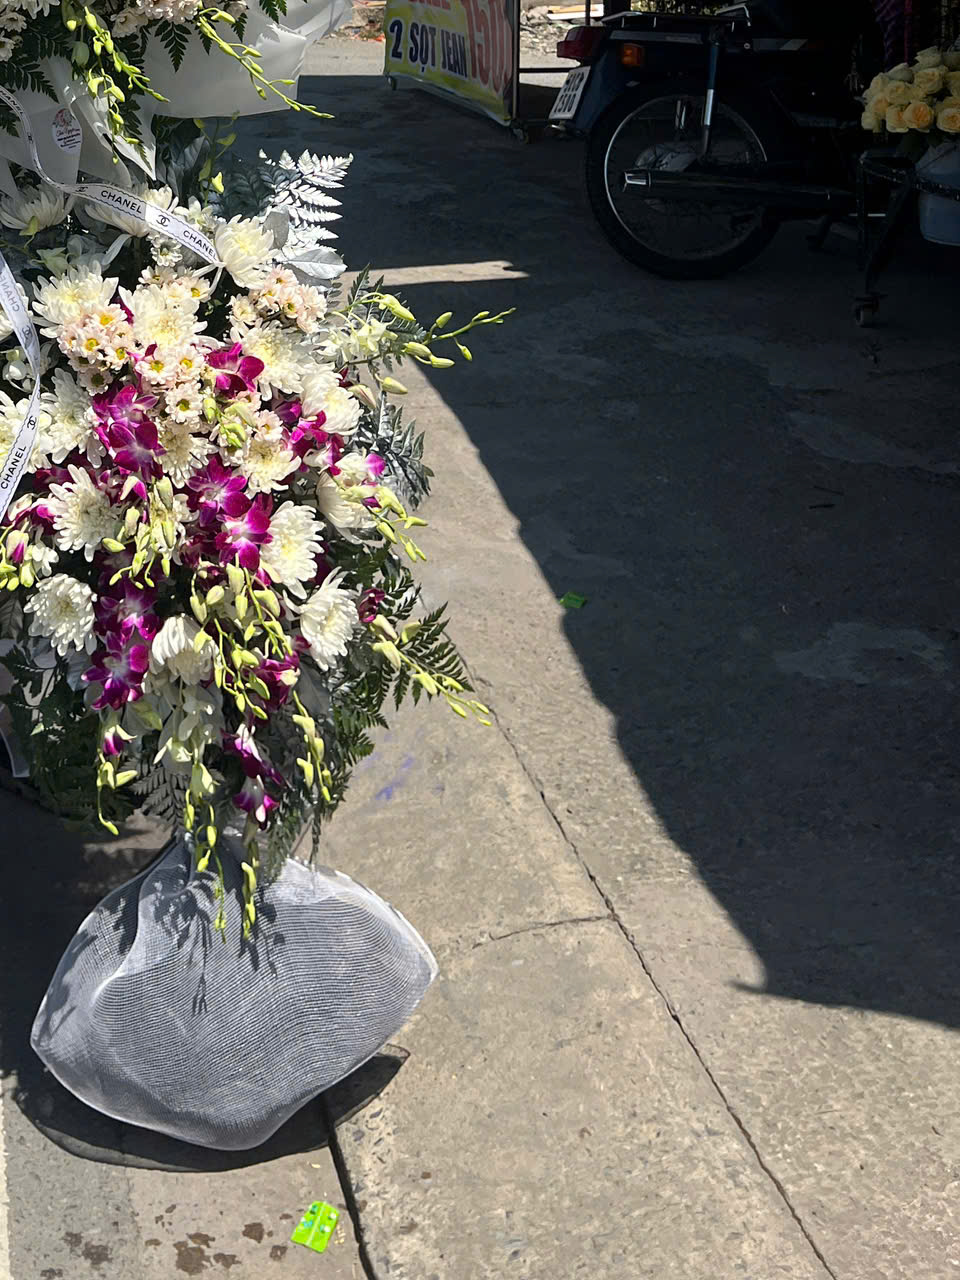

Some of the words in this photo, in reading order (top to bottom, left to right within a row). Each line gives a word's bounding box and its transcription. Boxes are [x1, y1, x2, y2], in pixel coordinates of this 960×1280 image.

[390, 19, 404, 60] 2
[408, 22, 437, 73] SỌT
[441, 28, 468, 78] JEAN
[101, 190, 143, 215] CHANEL
[0, 445, 27, 490] CHANEL
